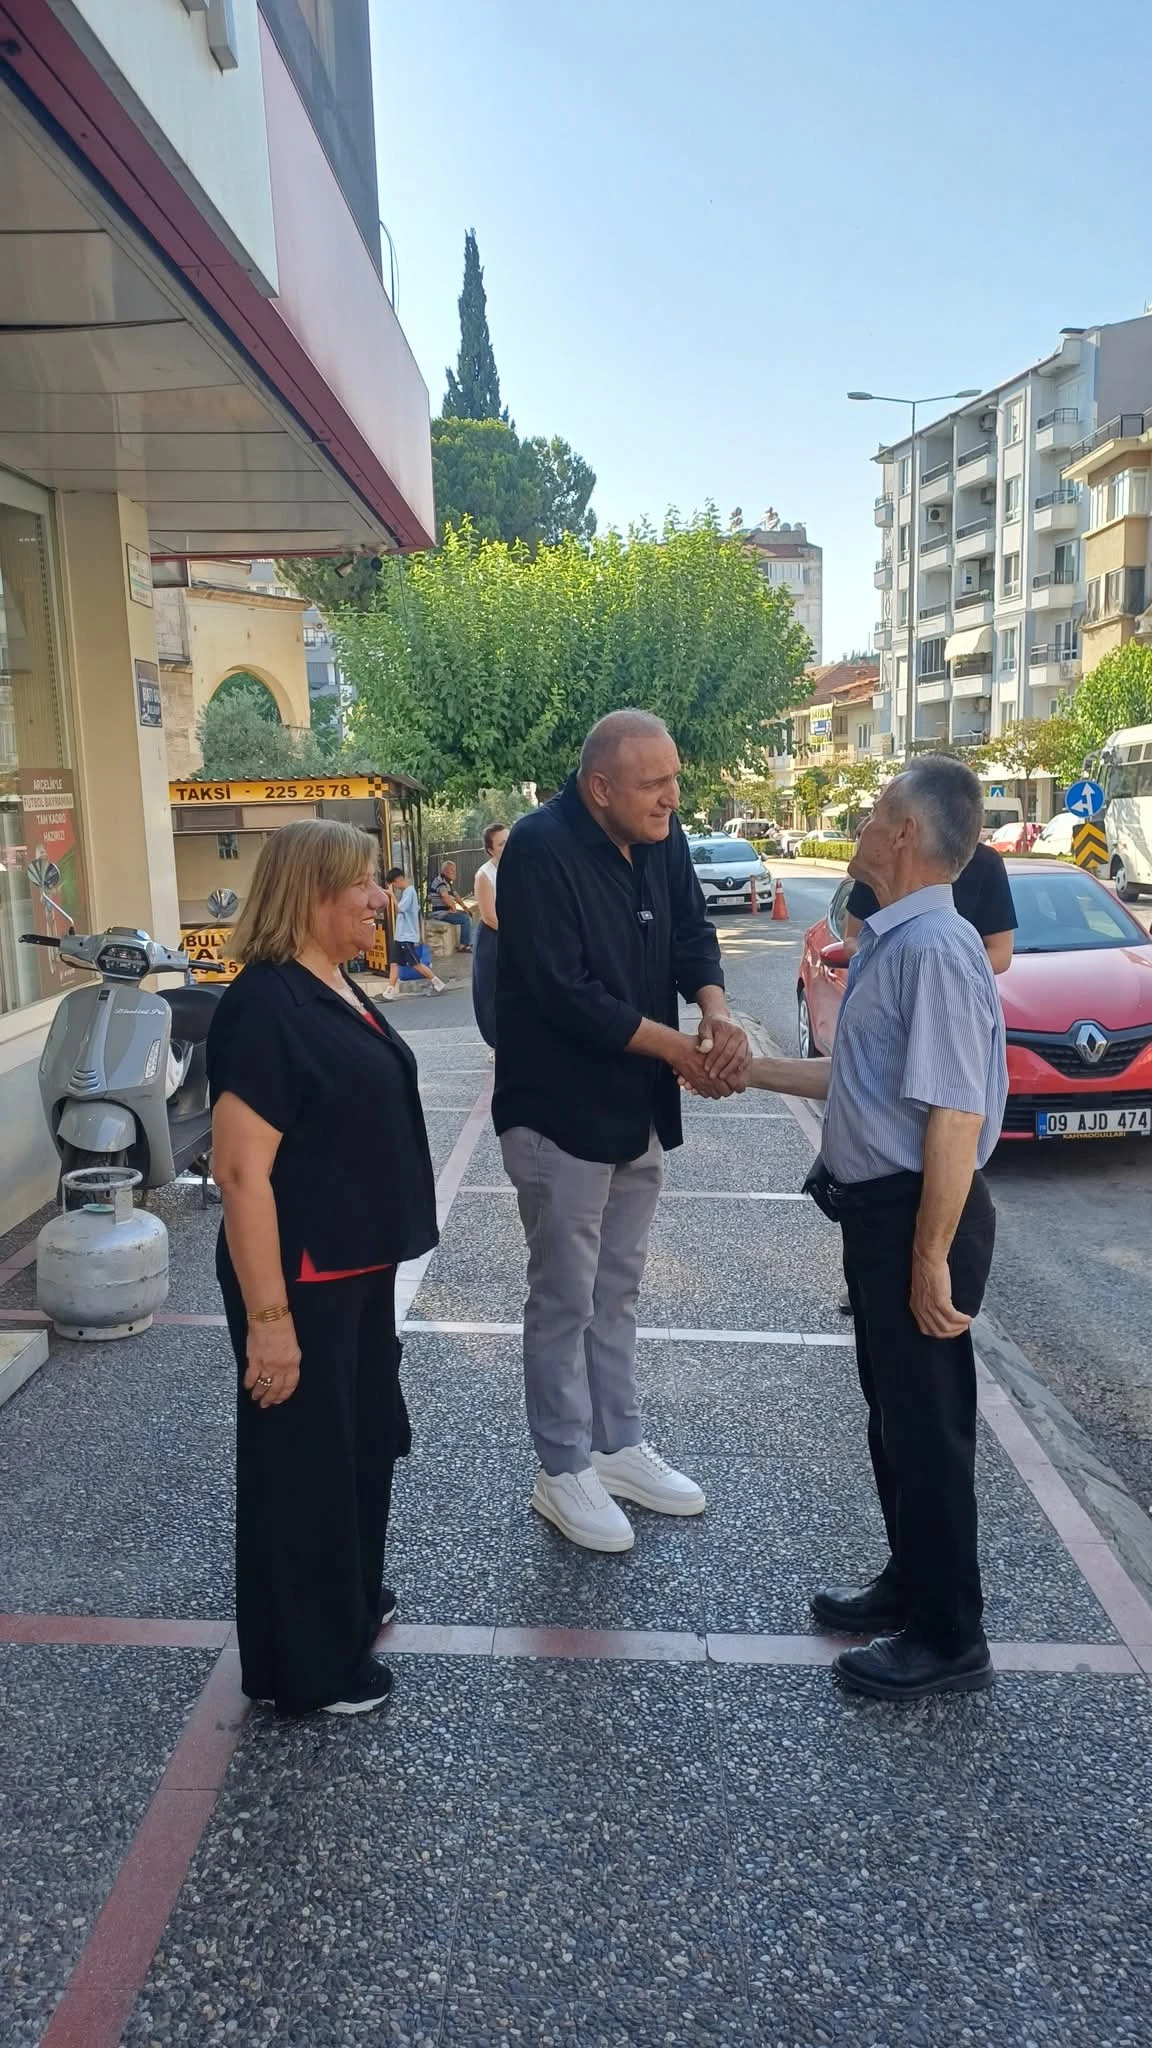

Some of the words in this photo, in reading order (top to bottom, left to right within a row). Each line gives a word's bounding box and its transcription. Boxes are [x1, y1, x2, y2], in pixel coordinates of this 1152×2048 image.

[176, 784, 231, 800] TAKSİ
[265, 786, 298, 799] 225
[304, 785, 325, 798] 25
[329, 784, 351, 797] 78
[1048, 1114, 1068, 1132] 09
[1078, 1112, 1108, 1131] AJD
[1117, 1110, 1147, 1129] 474
